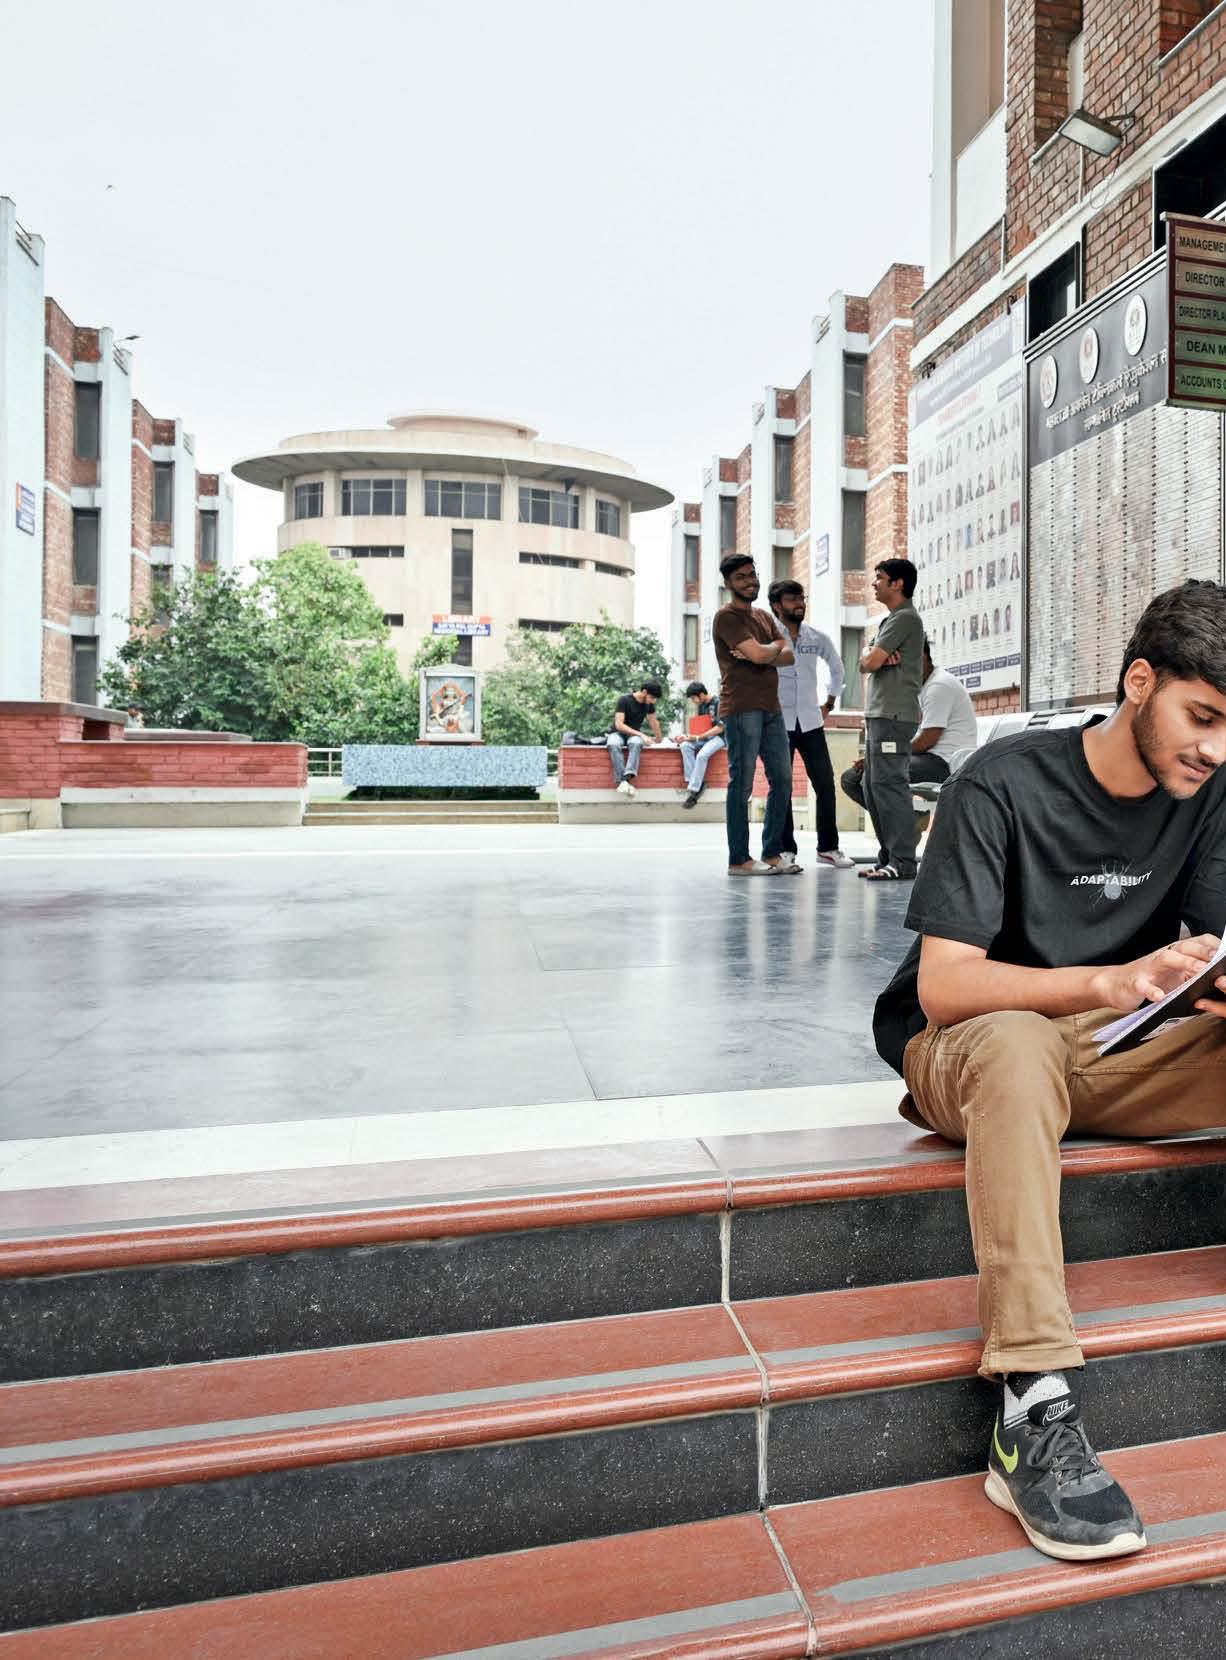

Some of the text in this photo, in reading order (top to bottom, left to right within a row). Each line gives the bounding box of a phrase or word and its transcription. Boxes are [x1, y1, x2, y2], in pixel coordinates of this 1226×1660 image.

[1185, 271, 1226, 288] DIRECTOR
[1179, 305, 1212, 319] DIRECTOR
[1186, 340, 1216, 355] DEAN
[1180, 375, 1222, 390] ACCOUNTS
[1070, 870, 1152, 887] ADAPTABILITY
[1046, 1399, 1069, 1417] NIKE
